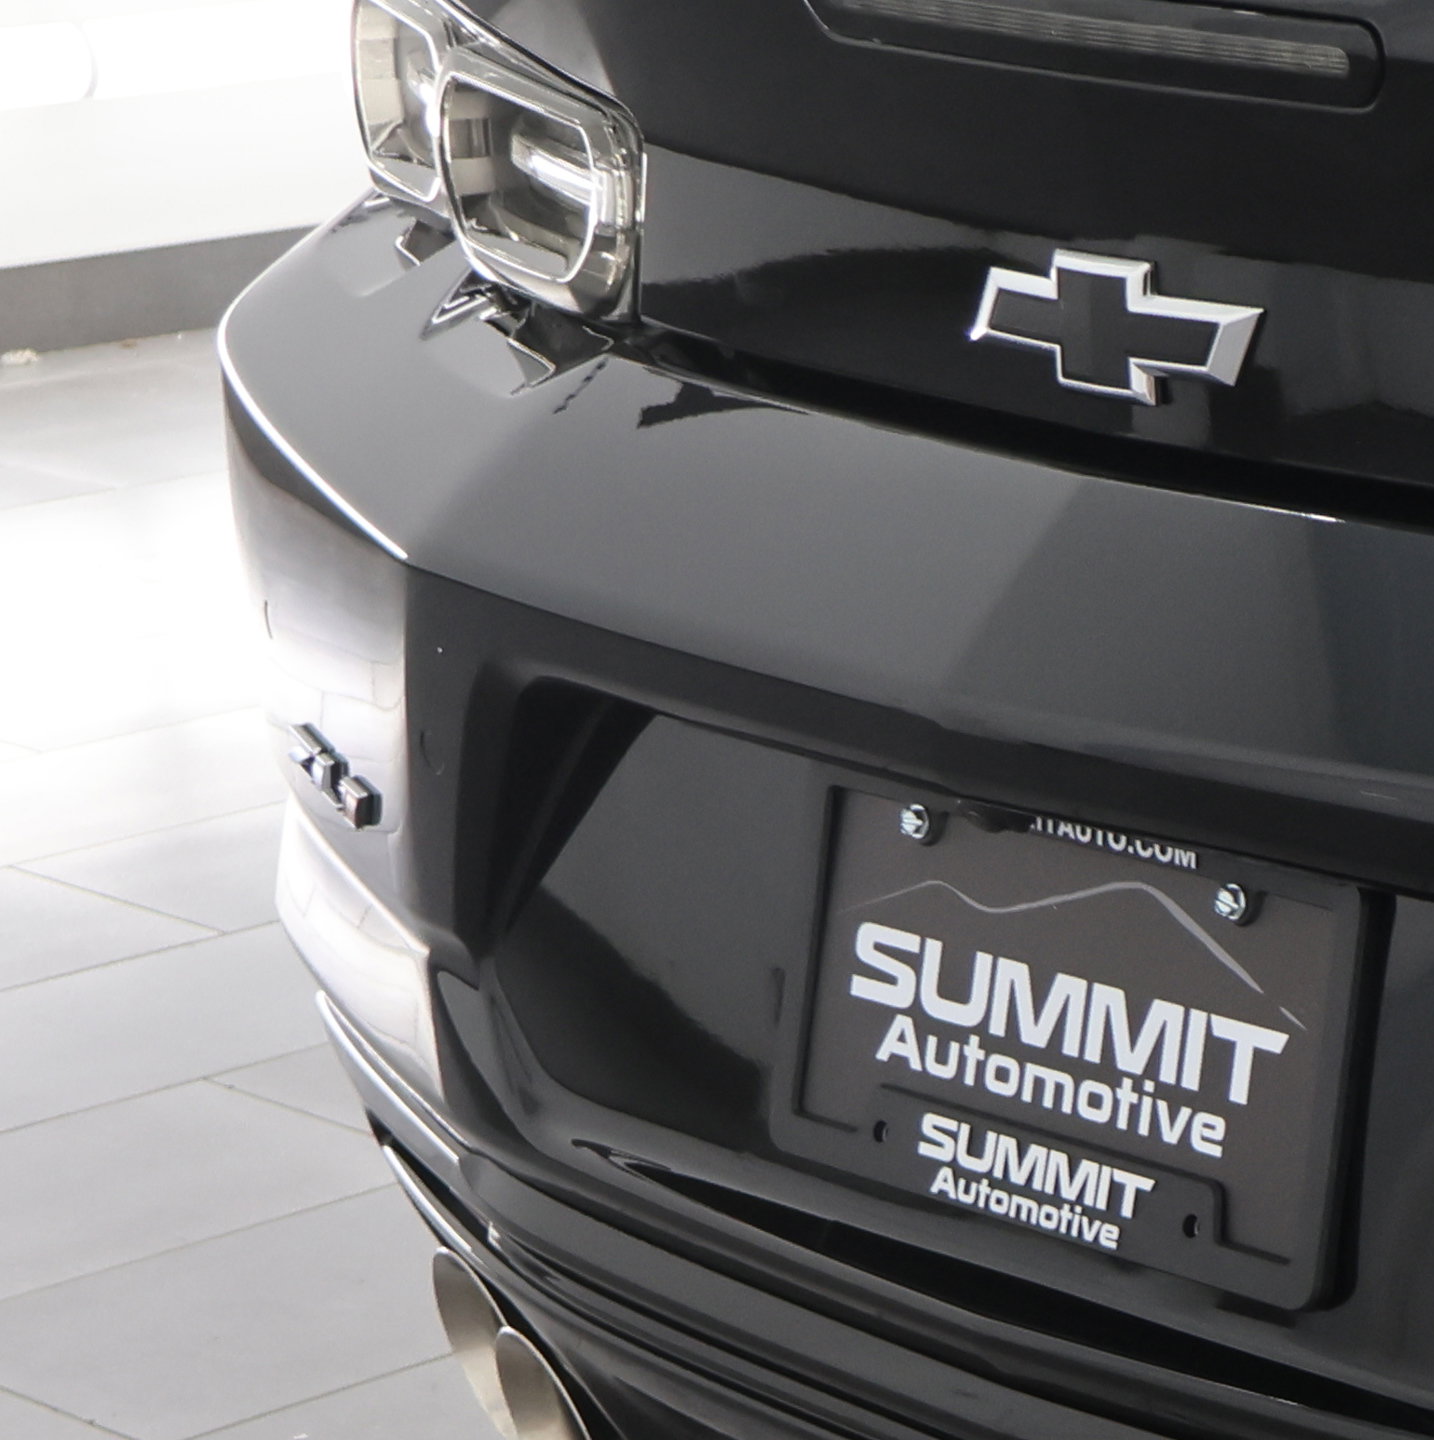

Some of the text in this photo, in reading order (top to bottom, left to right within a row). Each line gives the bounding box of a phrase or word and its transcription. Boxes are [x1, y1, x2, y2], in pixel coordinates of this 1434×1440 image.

[849, 921, 1290, 1106] SUMMIT
[875, 1013, 1227, 1159] Automotive
[917, 1112, 1156, 1219] SUMMIT
[929, 1166, 1120, 1250] Automotive
